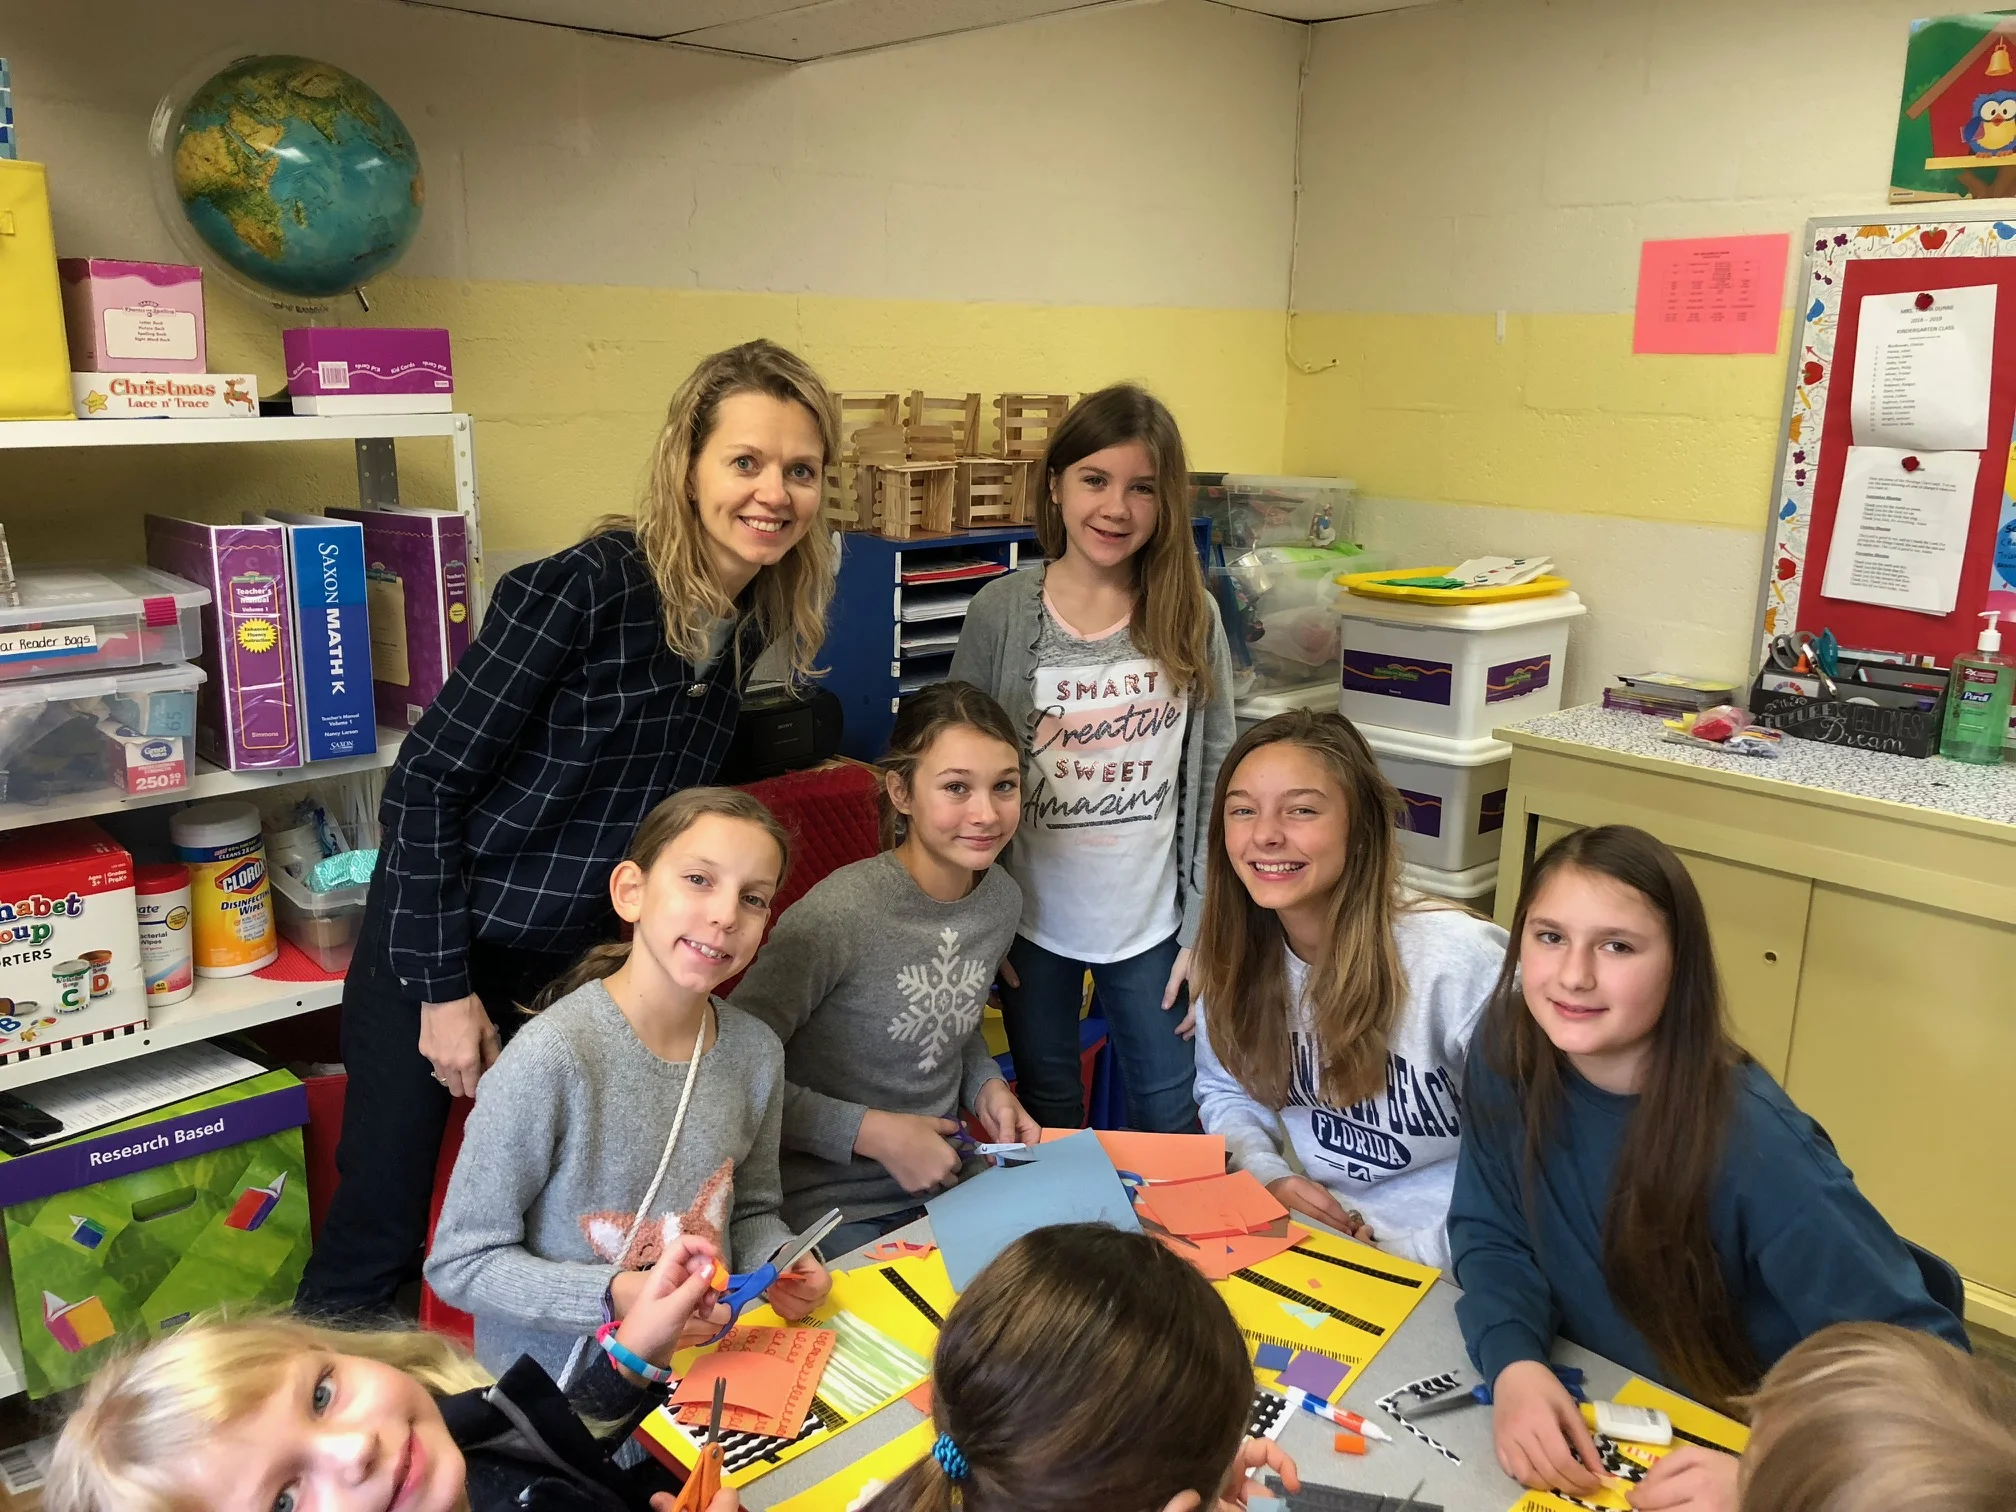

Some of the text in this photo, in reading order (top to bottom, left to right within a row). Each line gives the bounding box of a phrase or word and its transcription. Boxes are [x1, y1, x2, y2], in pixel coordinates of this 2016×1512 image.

[400, 362, 415, 371] Cards
[109, 378, 216, 396] Christmas
[128, 398, 157, 408] Lace
[174, 398, 209, 408] Trace
[318, 542, 339, 603] SAXON
[0, 635, 90, 651] ar Reader Bags
[326, 608, 343, 676] MATH
[332, 681, 345, 695] K
[1057, 672, 1158, 701] SMART
[1964, 692, 1990, 702] Purell
[1764, 703, 1834, 729] FUTURE
[1024, 702, 1180, 757] Creative
[1815, 716, 1905, 752] Dream
[145, 746, 166, 754] Great
[330, 740, 353, 750] SAXON
[1054, 758, 1153, 782] SWEET
[136, 775, 168, 791] 250
[1023, 777, 1171, 828] Amazing
[223, 860, 266, 893] CLOROX
[239, 901, 264, 915] WIPES
[0, 948, 52, 967] RTERS
[93, 974, 109, 992] D
[62, 989, 79, 1006] C
[0, 1018, 21, 1032] B
[90, 1118, 225, 1166] Research Based
[1317, 1112, 1406, 1165] FLORIDA
